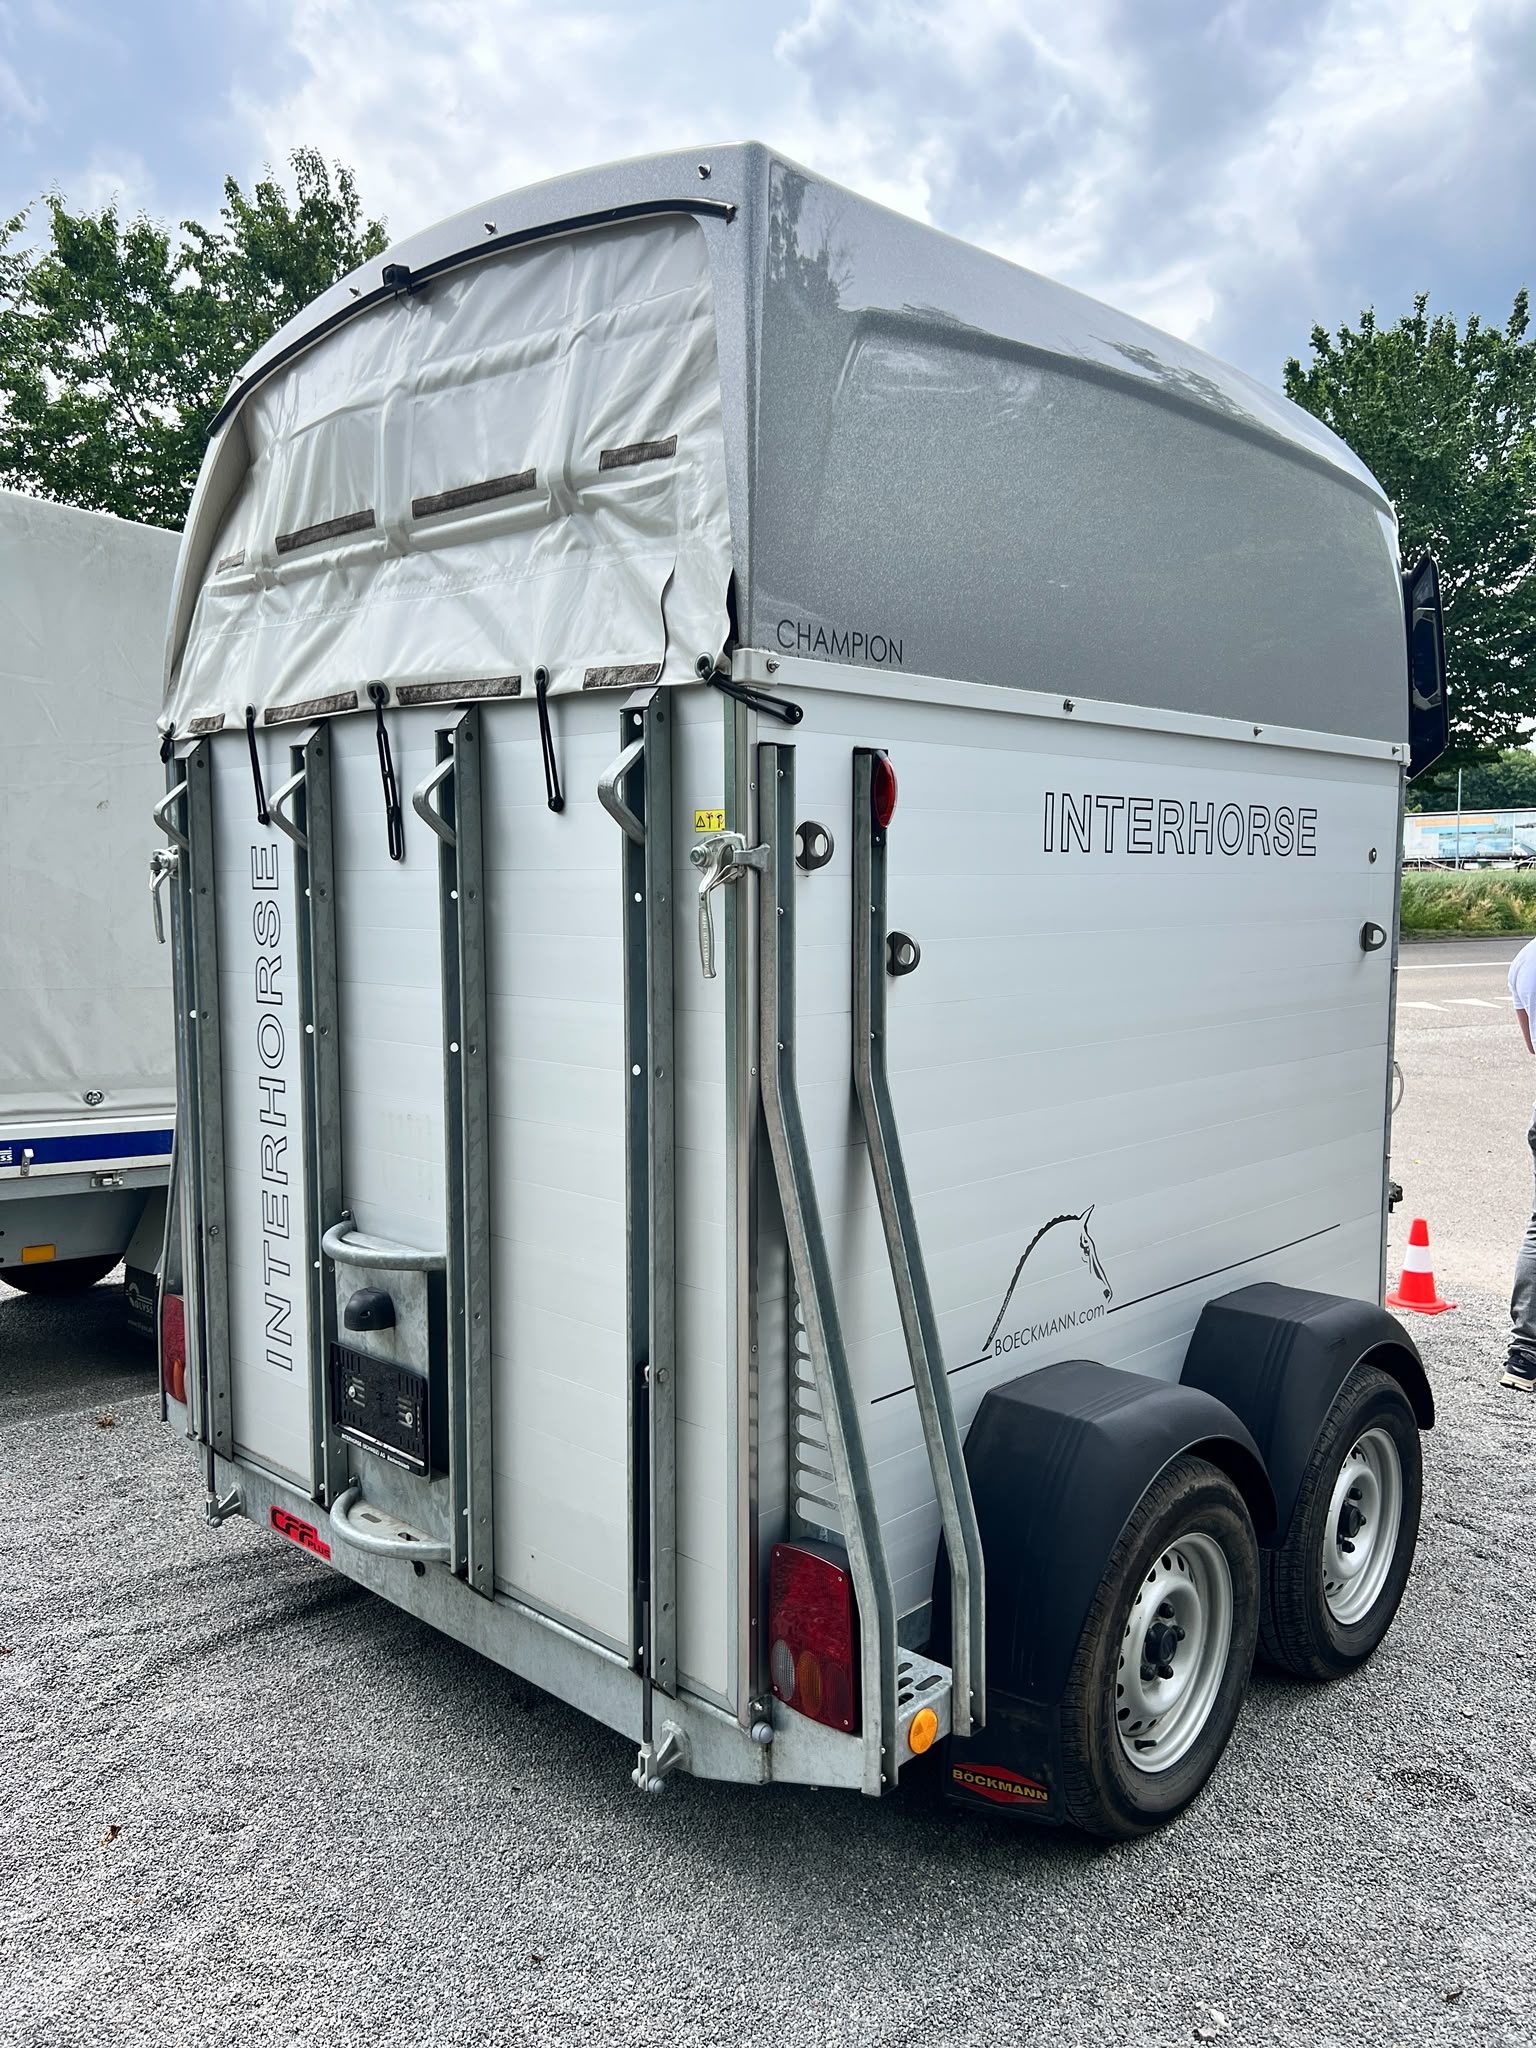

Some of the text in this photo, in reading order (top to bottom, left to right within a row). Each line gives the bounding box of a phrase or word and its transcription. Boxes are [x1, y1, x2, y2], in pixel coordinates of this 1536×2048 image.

[776, 619, 903, 664] CHAMPION
[1043, 791, 1318, 857] INTERHORSE
[250, 842, 293, 1372] INTERHORSE
[994, 1304, 1105, 1357] BOECKMANN.com
[307, 1540, 331, 1559] PLUS
[952, 1768, 1048, 1801] BÖCKMANN
